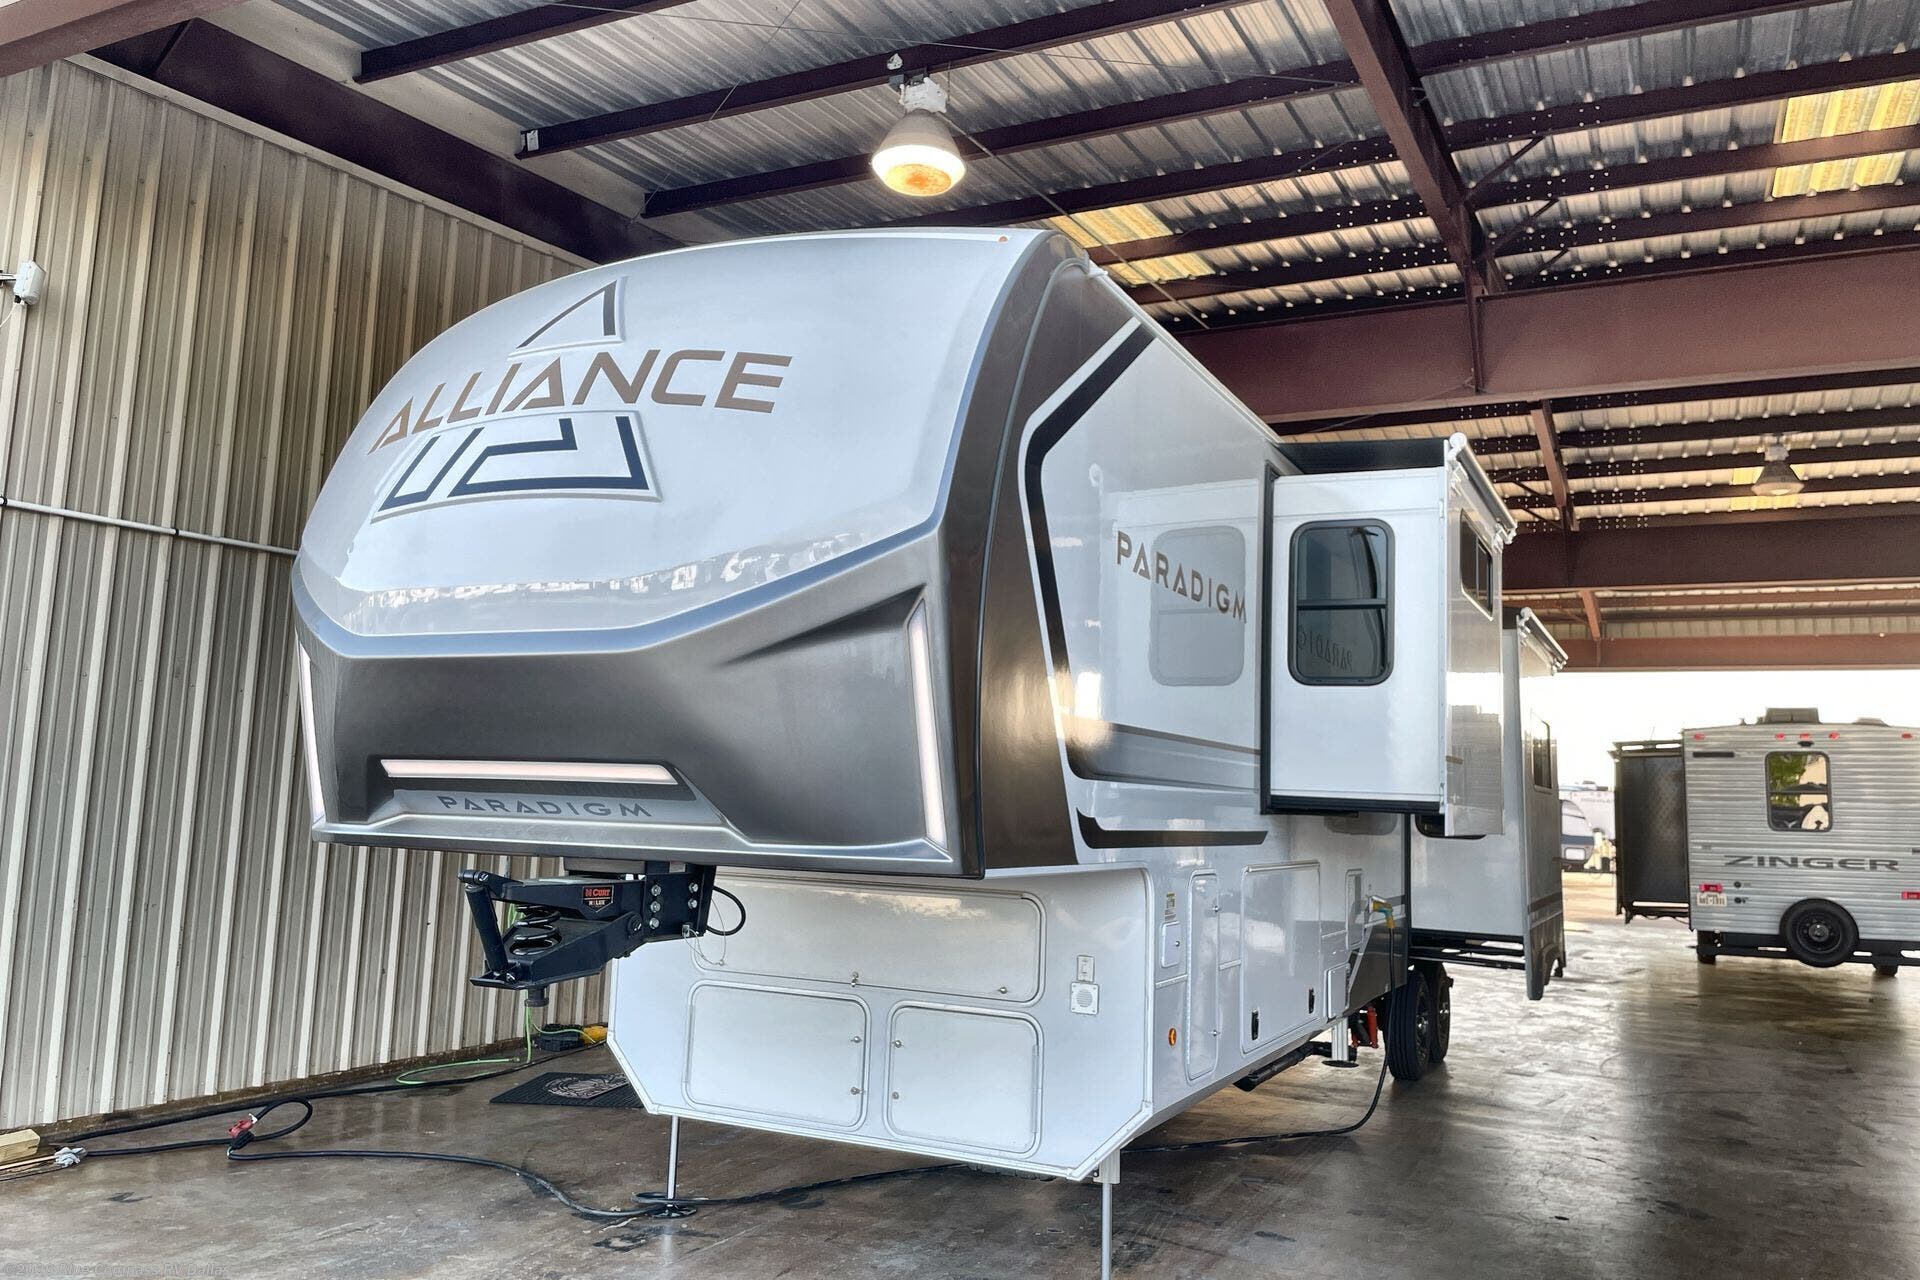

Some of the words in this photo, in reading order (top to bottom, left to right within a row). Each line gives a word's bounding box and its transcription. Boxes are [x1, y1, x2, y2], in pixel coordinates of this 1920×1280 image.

[367, 349, 793, 455] ALLIANCE
[1117, 530, 1247, 624] PARADIGM
[436, 795, 652, 817] PARADIGM
[1724, 854, 1899, 872] ZINGER
